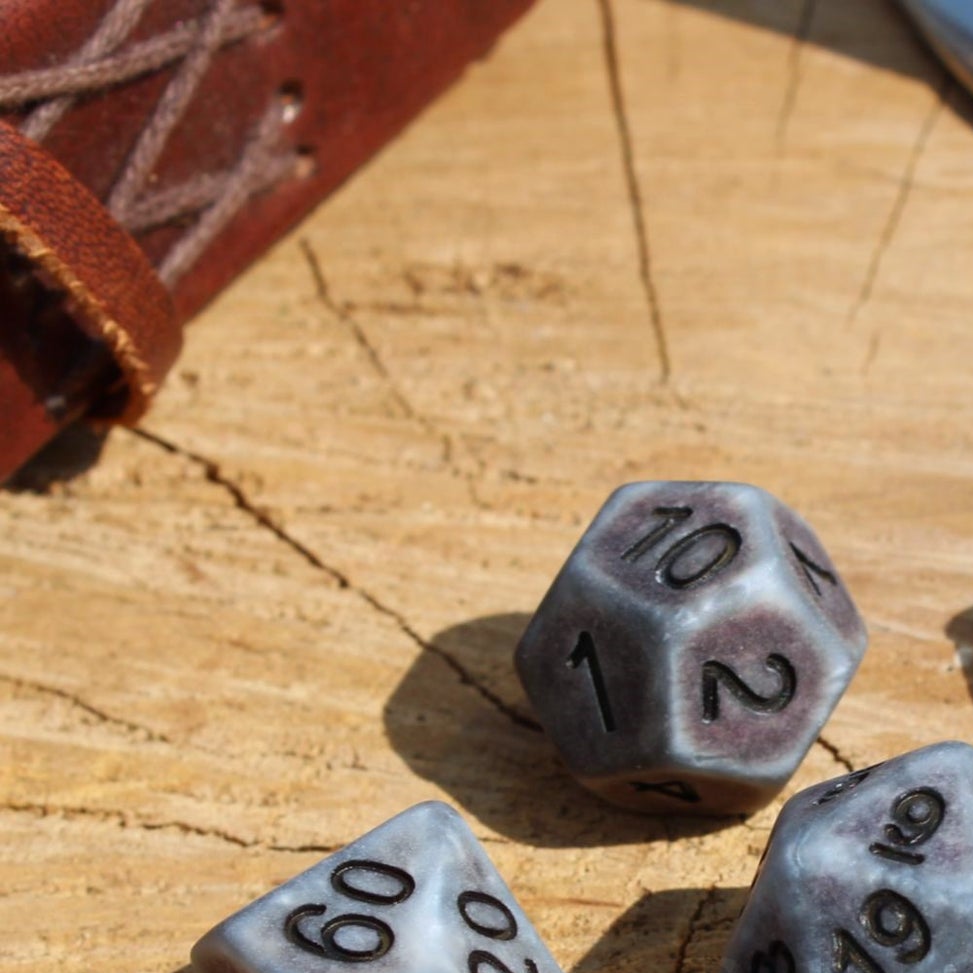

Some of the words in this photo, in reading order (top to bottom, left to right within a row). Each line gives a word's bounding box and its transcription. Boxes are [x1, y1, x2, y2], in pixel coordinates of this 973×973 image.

[620, 506, 743, 590] 10
[565, 630, 616, 733] 1
[702, 653, 797, 723] 2
[284, 858, 416, 963] 60
